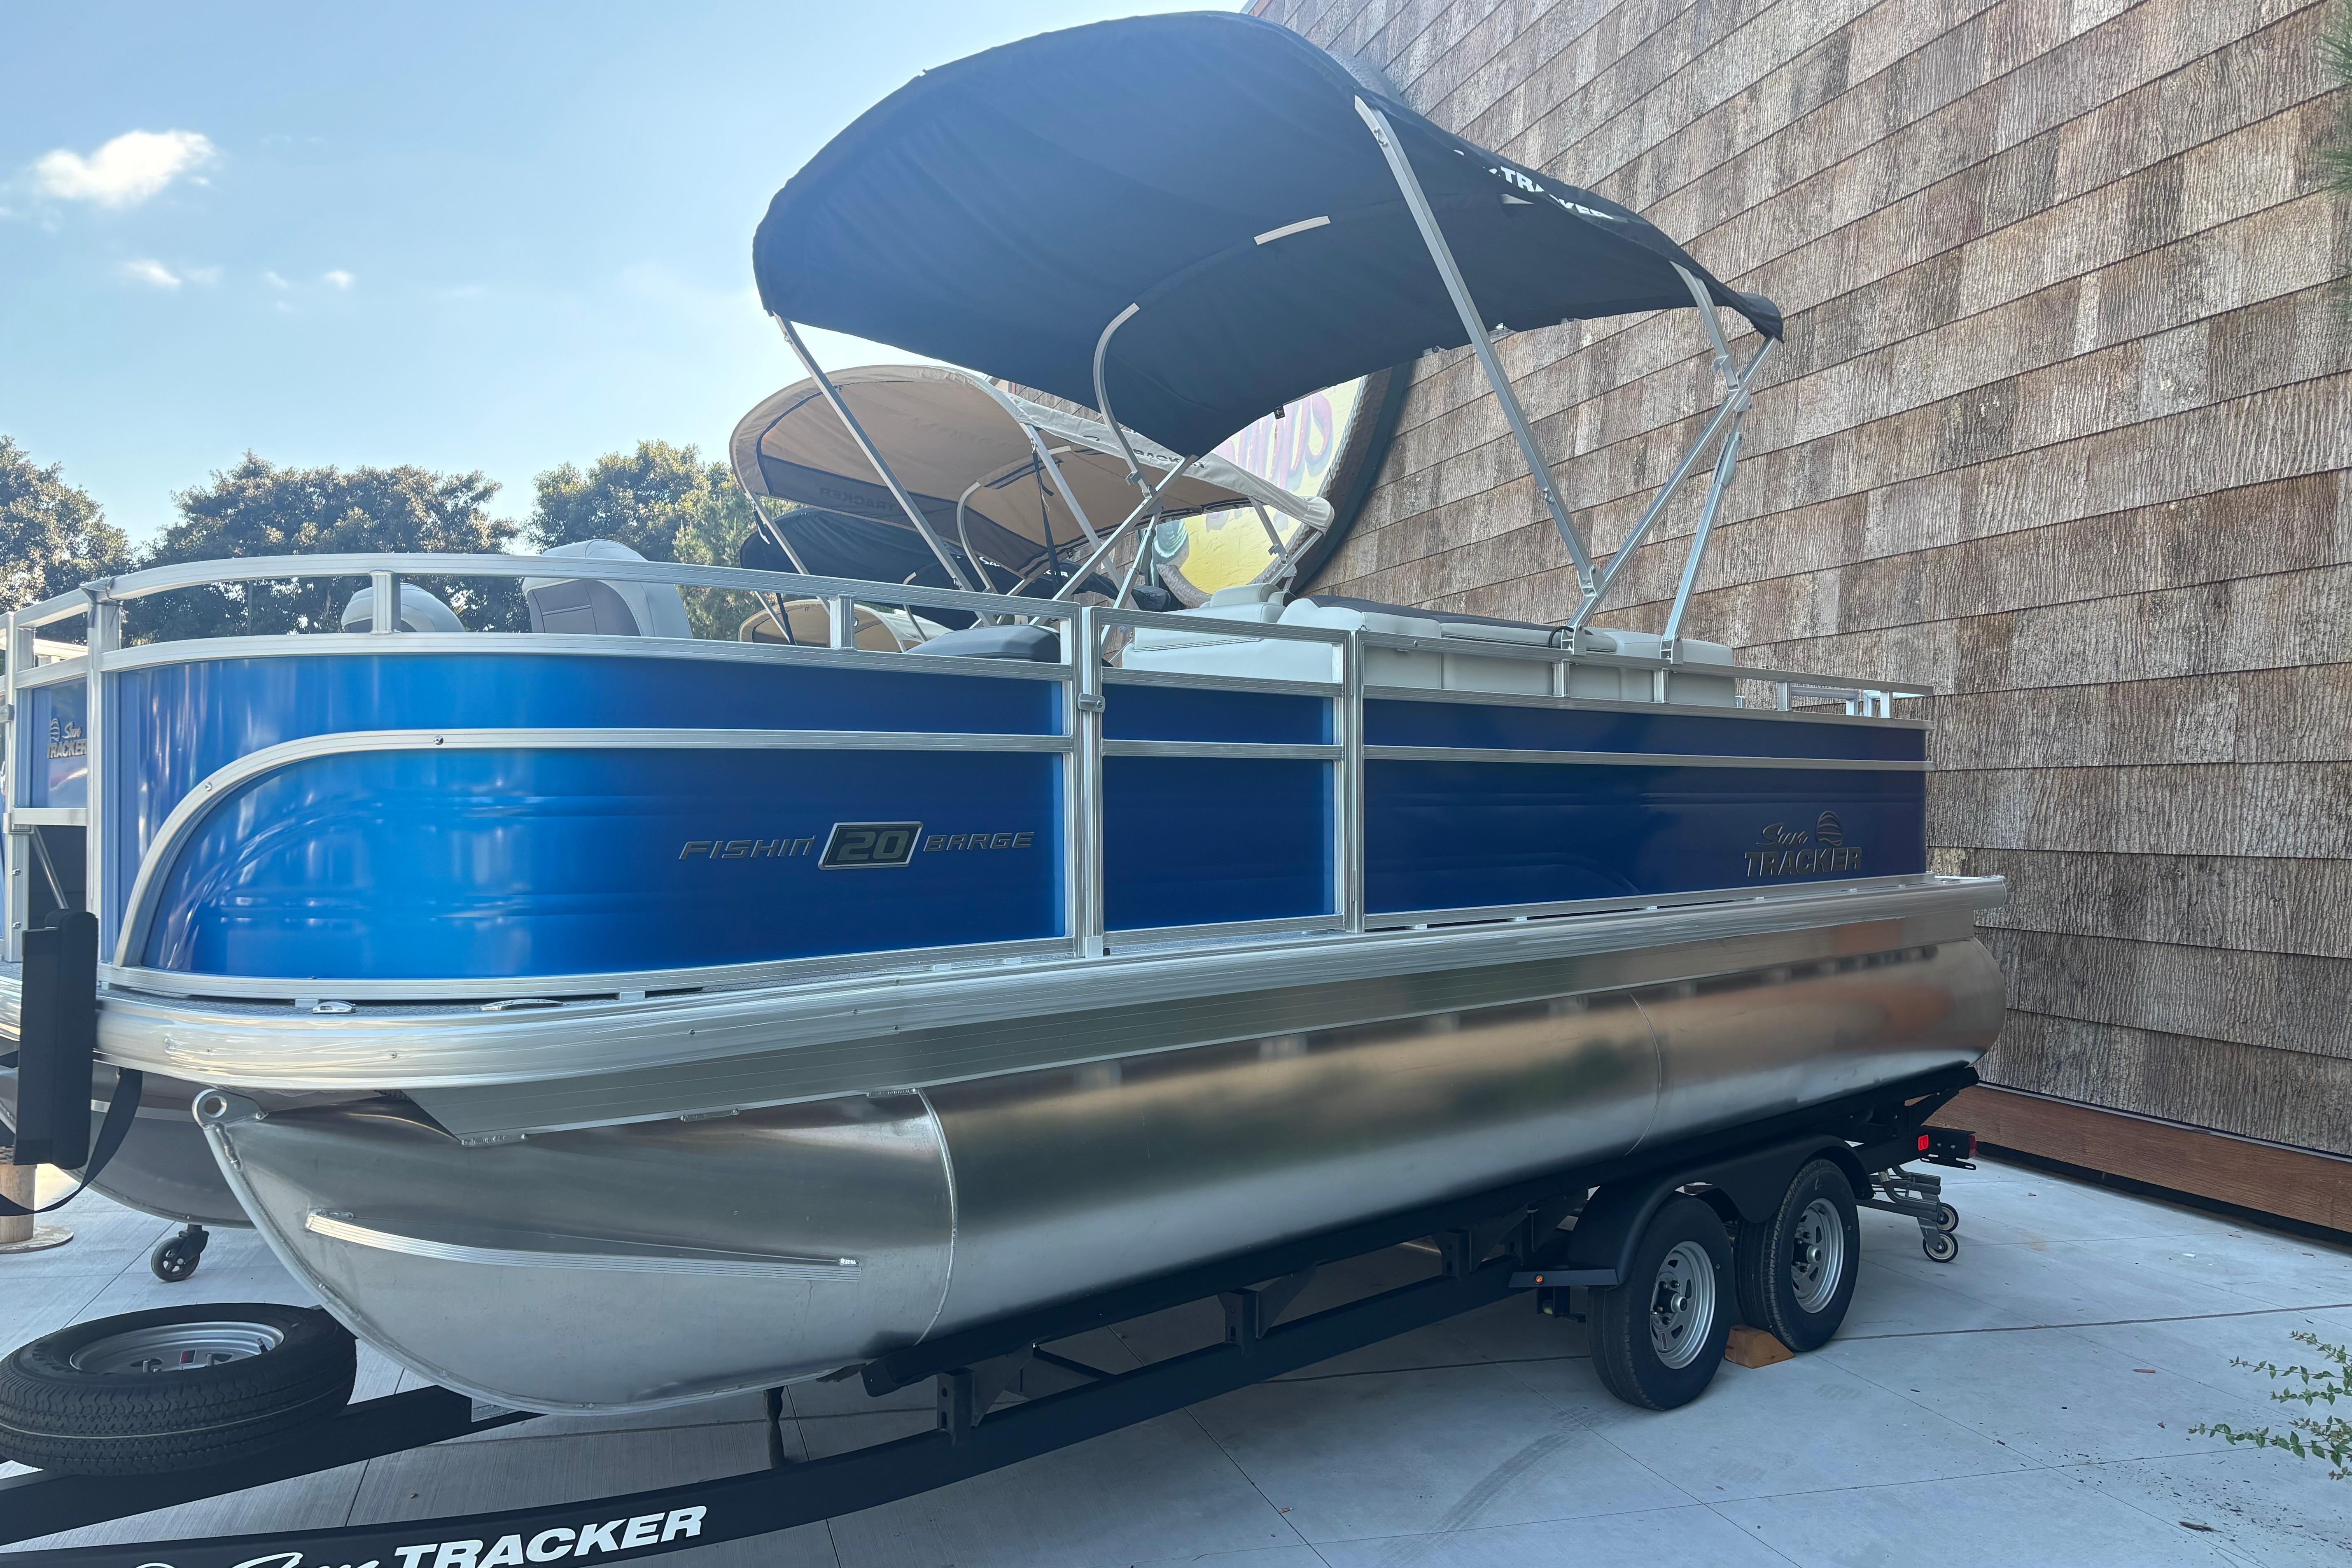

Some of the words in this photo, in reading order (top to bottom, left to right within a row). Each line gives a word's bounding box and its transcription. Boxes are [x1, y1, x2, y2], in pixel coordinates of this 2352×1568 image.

[62, 721, 82, 739] Sun
[47, 739, 87, 759] TRACKER
[837, 831, 909, 861] 20
[923, 832, 1034, 852] BARGE
[1756, 823, 1808, 847] Sun
[1745, 847, 1862, 877] TRACKER
[394, 1505, 707, 1568] TRACKER
